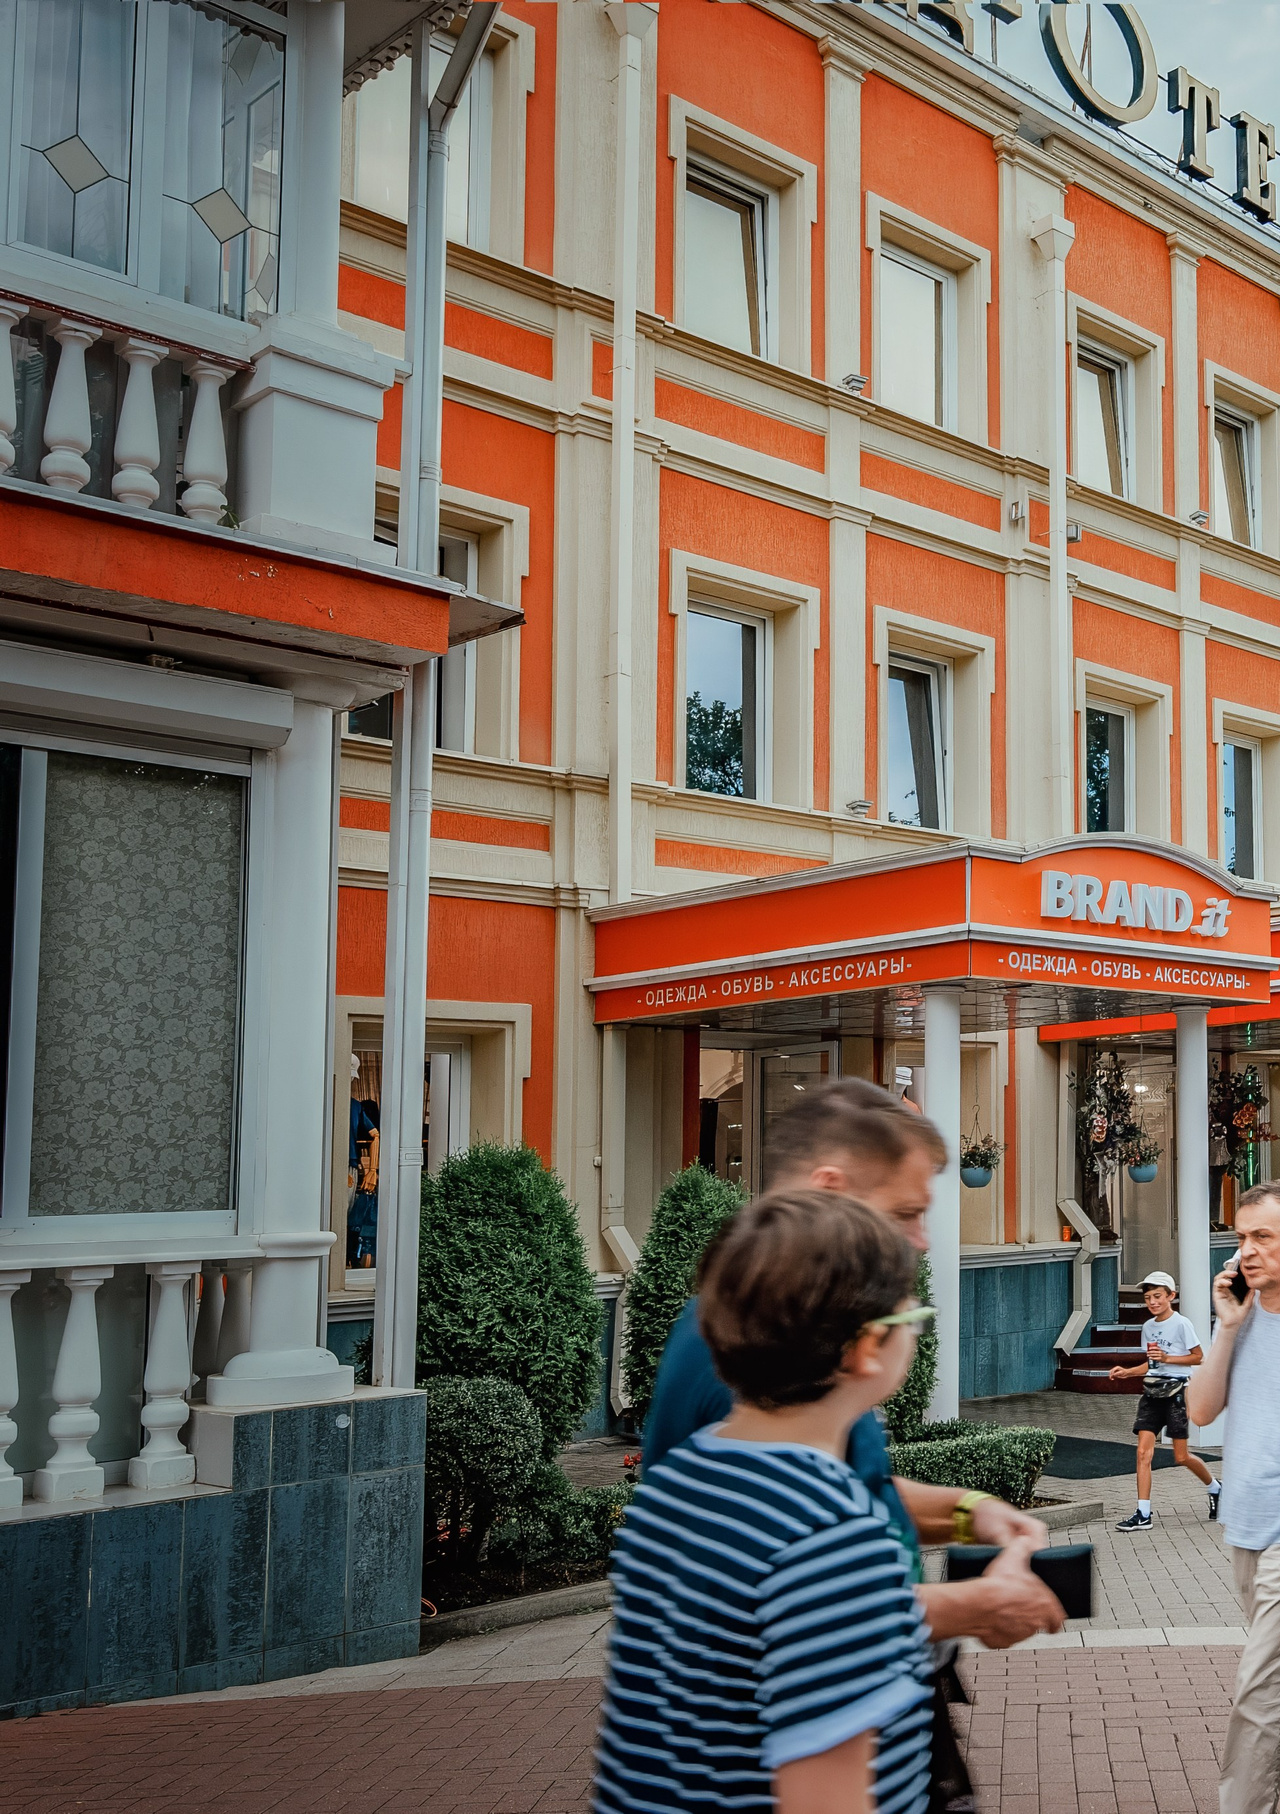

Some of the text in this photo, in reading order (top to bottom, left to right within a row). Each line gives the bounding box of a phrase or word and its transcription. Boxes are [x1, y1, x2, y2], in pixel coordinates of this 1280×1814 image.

[1008, 951, 1078, 976] ОДЕЖДА
[1091, 960, 1141, 980] ОБУВЬ
[645, 984, 707, 1007] ОДЕЖДА
[721, 975, 774, 997] ОБУВЬ
